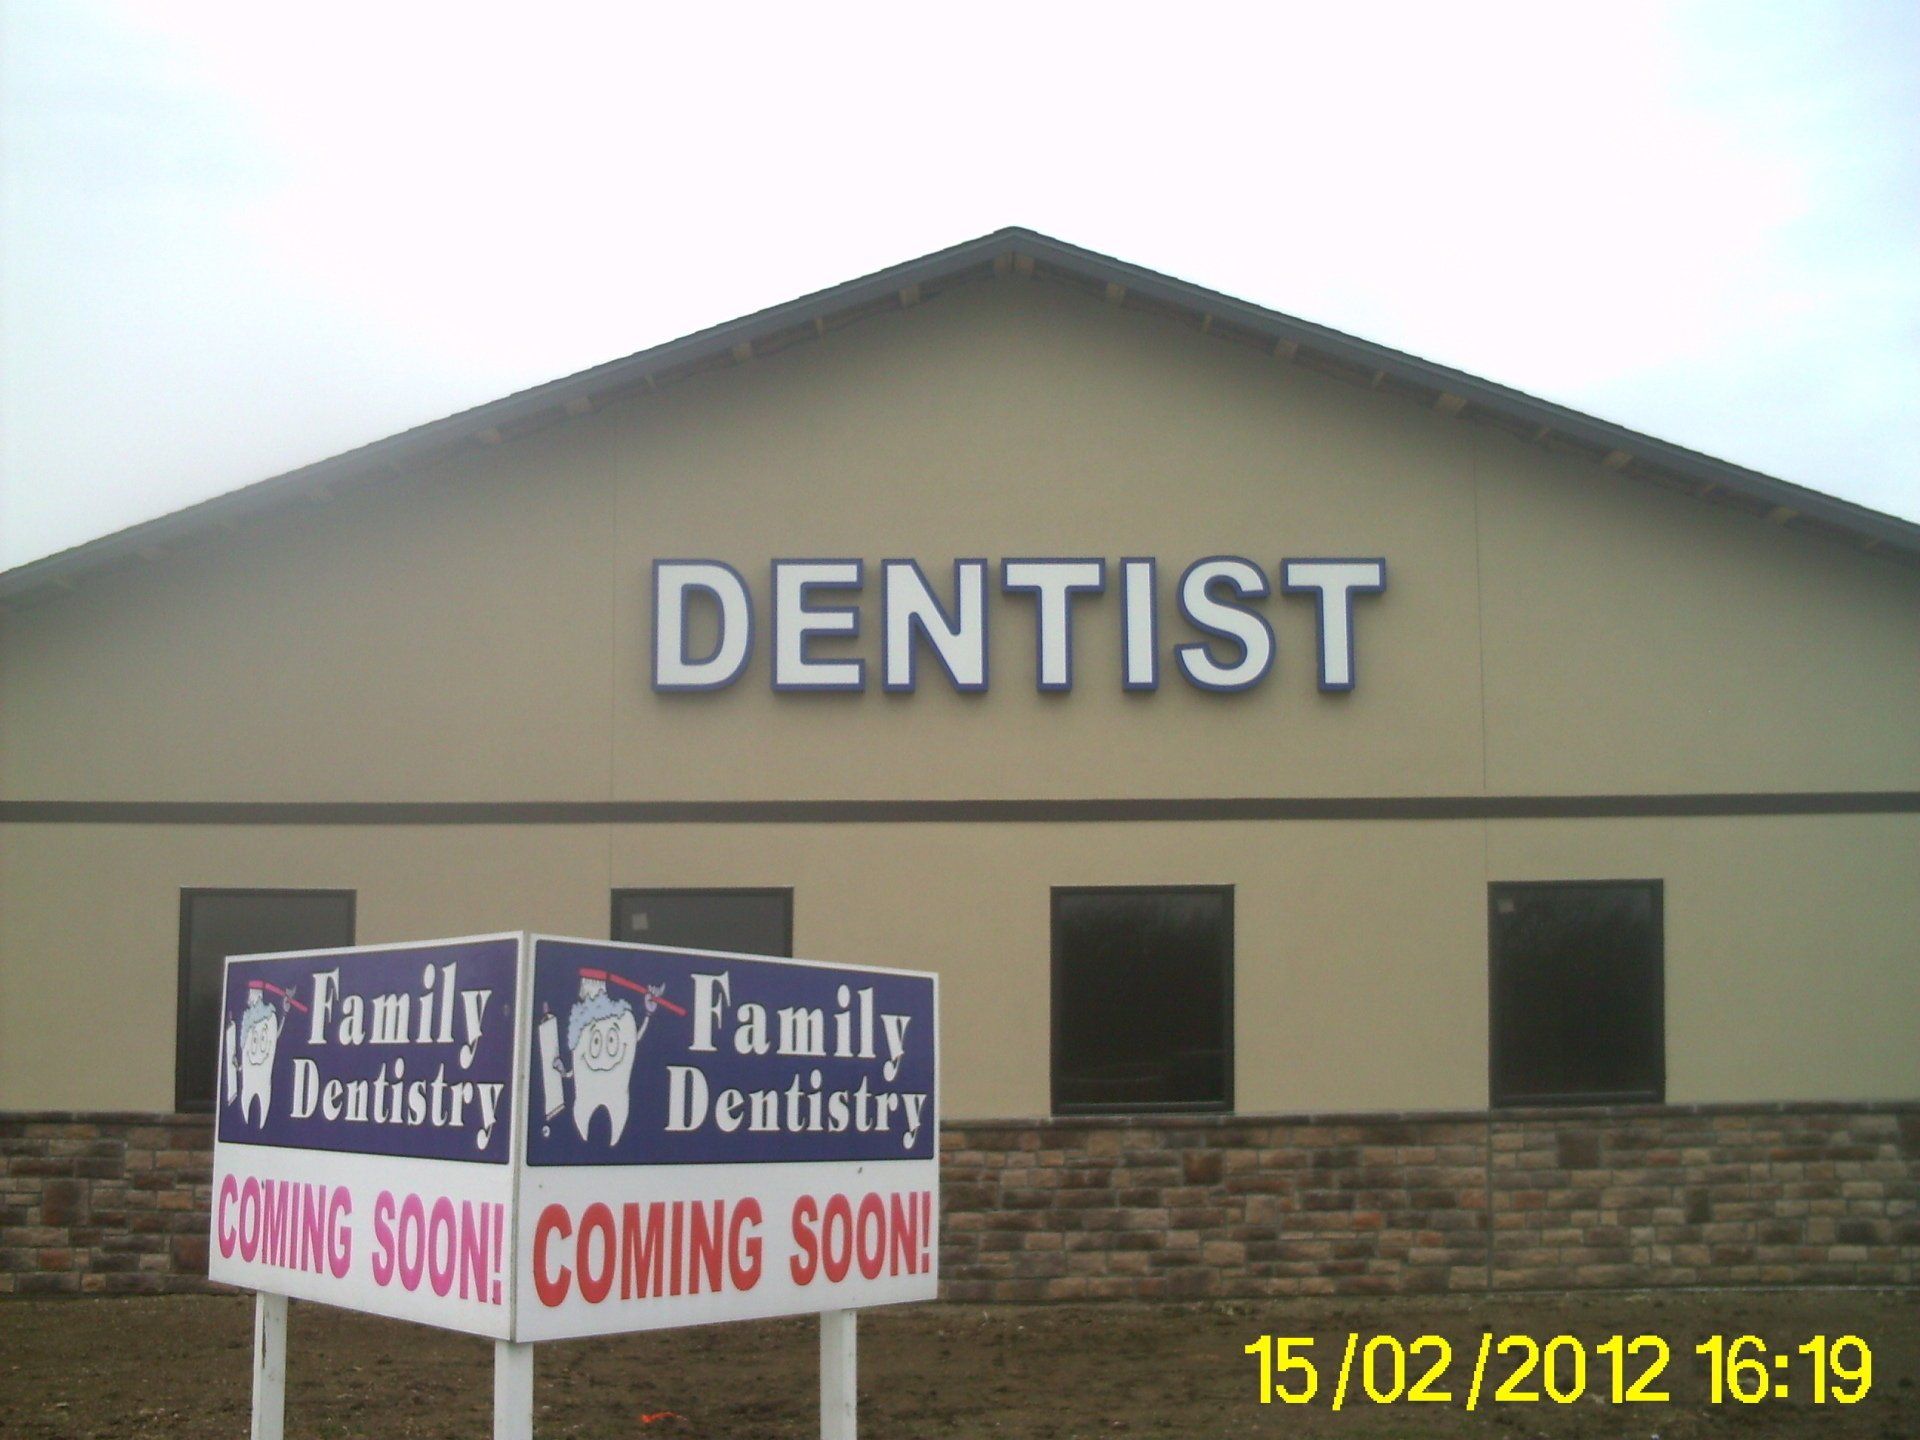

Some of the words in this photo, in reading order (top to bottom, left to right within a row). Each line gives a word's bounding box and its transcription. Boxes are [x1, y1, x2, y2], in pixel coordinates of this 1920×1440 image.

[652, 556, 1387, 693] DENTIST
[307, 962, 492, 1069] Family
[689, 970, 911, 1081] Family
[290, 1058, 504, 1150] Dentistry
[664, 1065, 927, 1150] Dentistry
[218, 1173, 352, 1279] COMING
[371, 1190, 504, 1305] SOON!
[533, 1196, 763, 1307] COMING
[789, 1191, 931, 1285] SOON!
